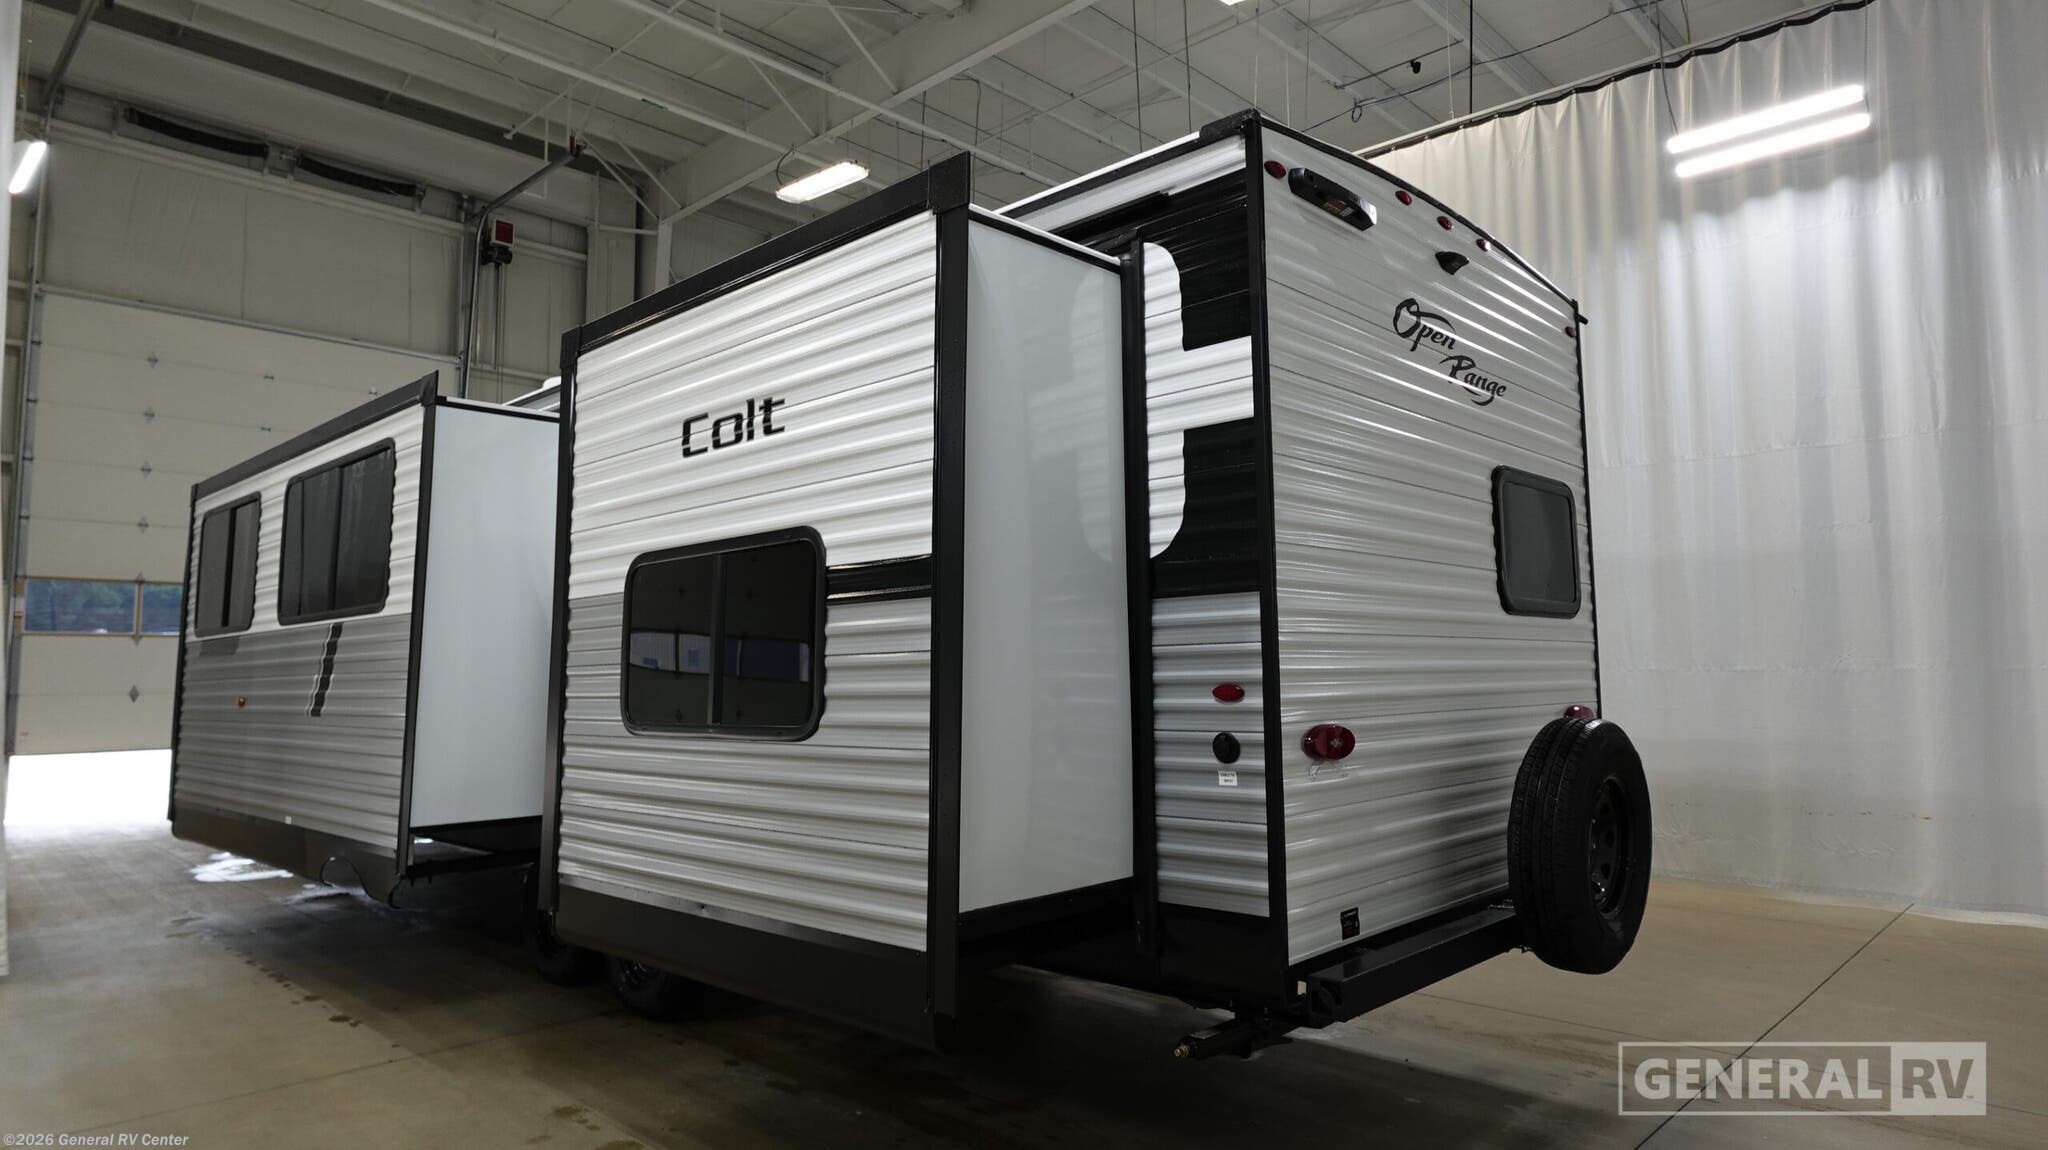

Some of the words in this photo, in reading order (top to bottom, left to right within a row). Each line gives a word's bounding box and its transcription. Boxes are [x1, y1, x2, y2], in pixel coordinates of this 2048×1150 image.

[1393, 298, 1456, 352] Open
[1440, 355, 1507, 406] Range
[682, 397, 785, 458] Colt
